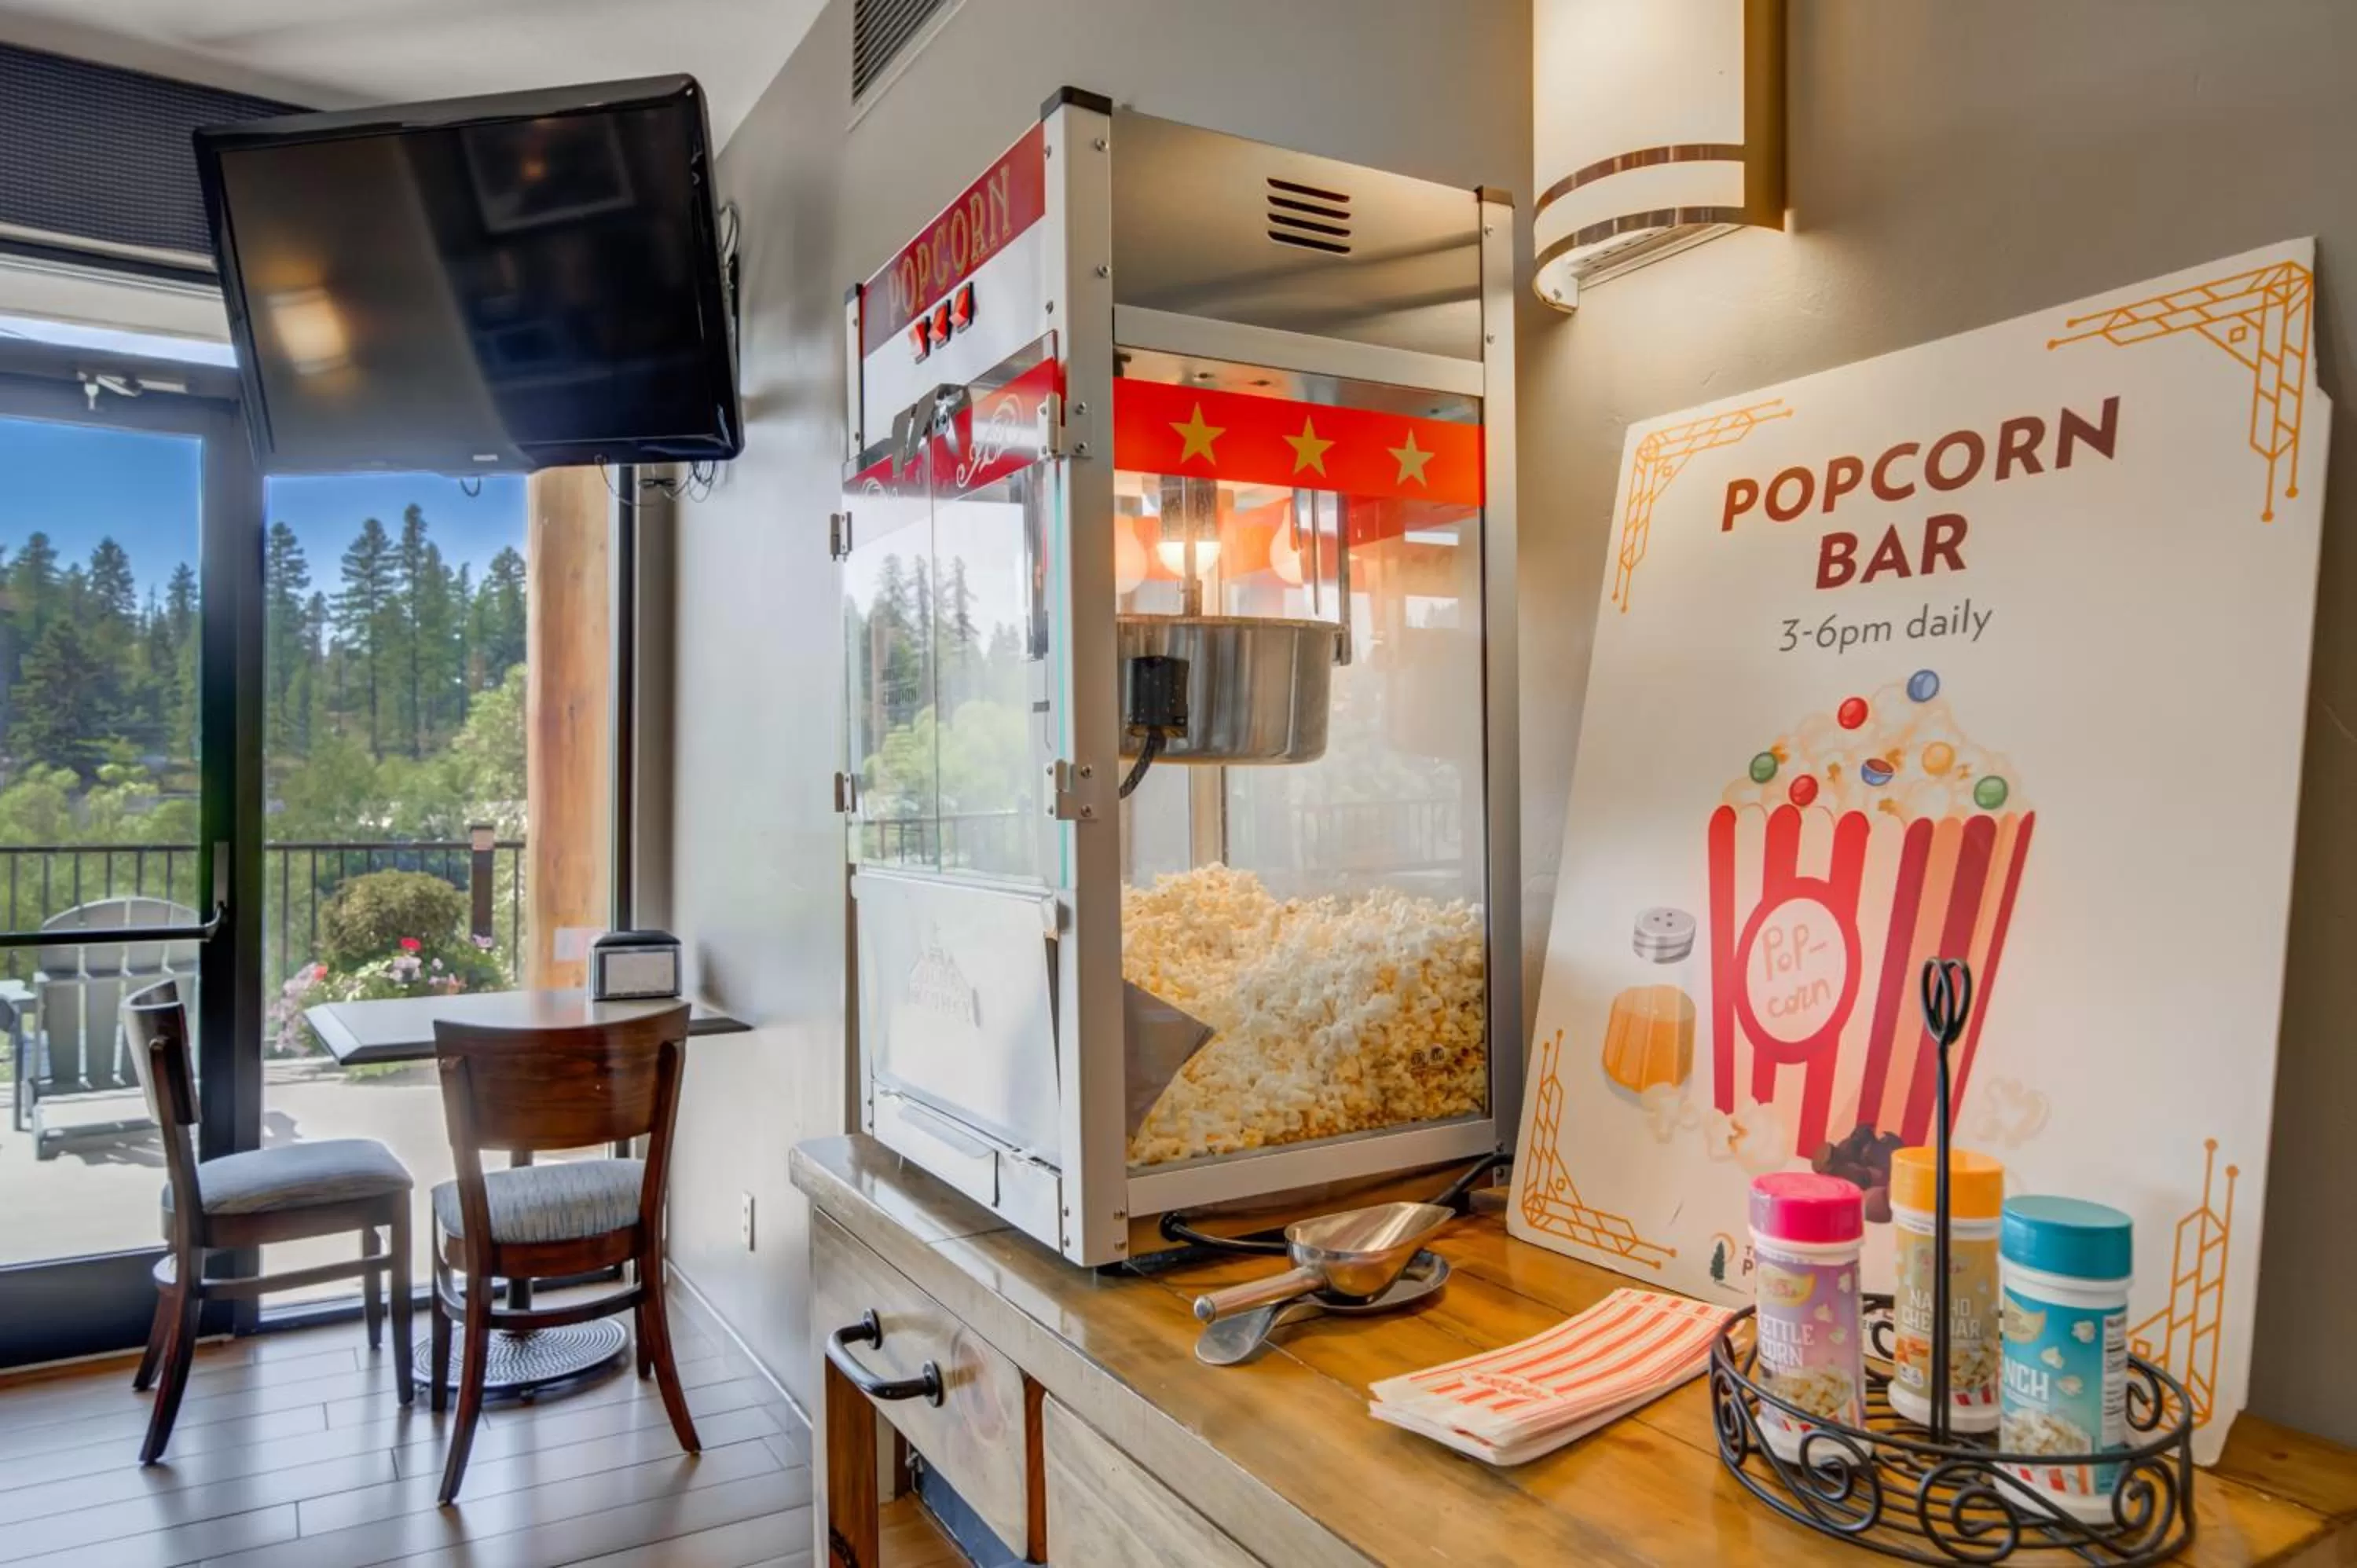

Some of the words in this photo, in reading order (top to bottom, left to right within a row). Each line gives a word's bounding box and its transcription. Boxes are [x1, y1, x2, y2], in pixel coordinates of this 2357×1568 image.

[886, 163, 1013, 332] POPCORN
[1721, 395, 2121, 532] POPCORN
[1815, 513, 1969, 590] BAR
[1779, 614, 1893, 654] 3-6pm
[1906, 598, 1993, 643] daily
[1901, 1304, 1981, 1339] CHEAR
[1910, 1288, 1971, 1317] NAHO
